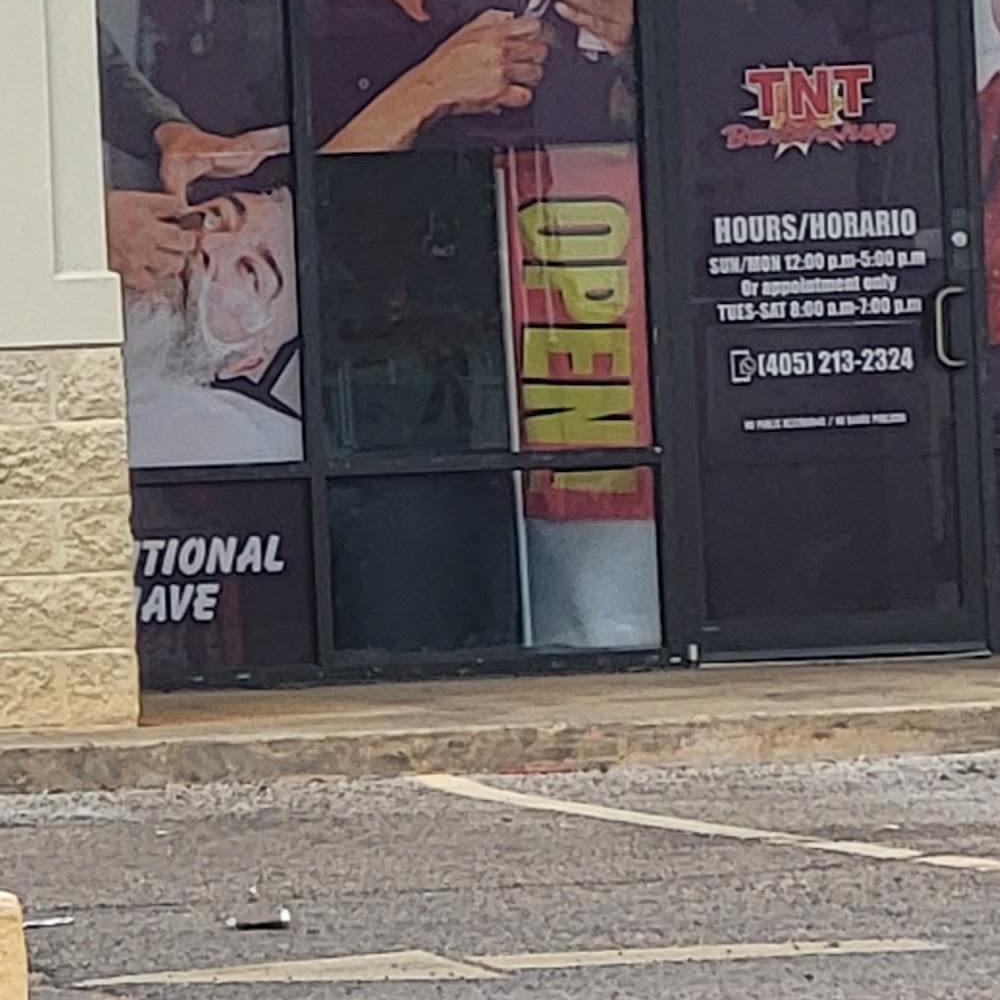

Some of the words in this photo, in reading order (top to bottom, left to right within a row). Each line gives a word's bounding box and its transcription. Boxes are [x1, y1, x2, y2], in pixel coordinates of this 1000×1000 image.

[745, 64, 873, 120] TNT
[714, 208, 917, 244] HOURS/HORARIO
[784, 251, 825, 271] 12:00
[863, 273, 898, 292] only
[716, 302, 787, 322] TUES-SAT
[757, 351, 815, 377] (405)
[817, 347, 915, 375] 213-2324
